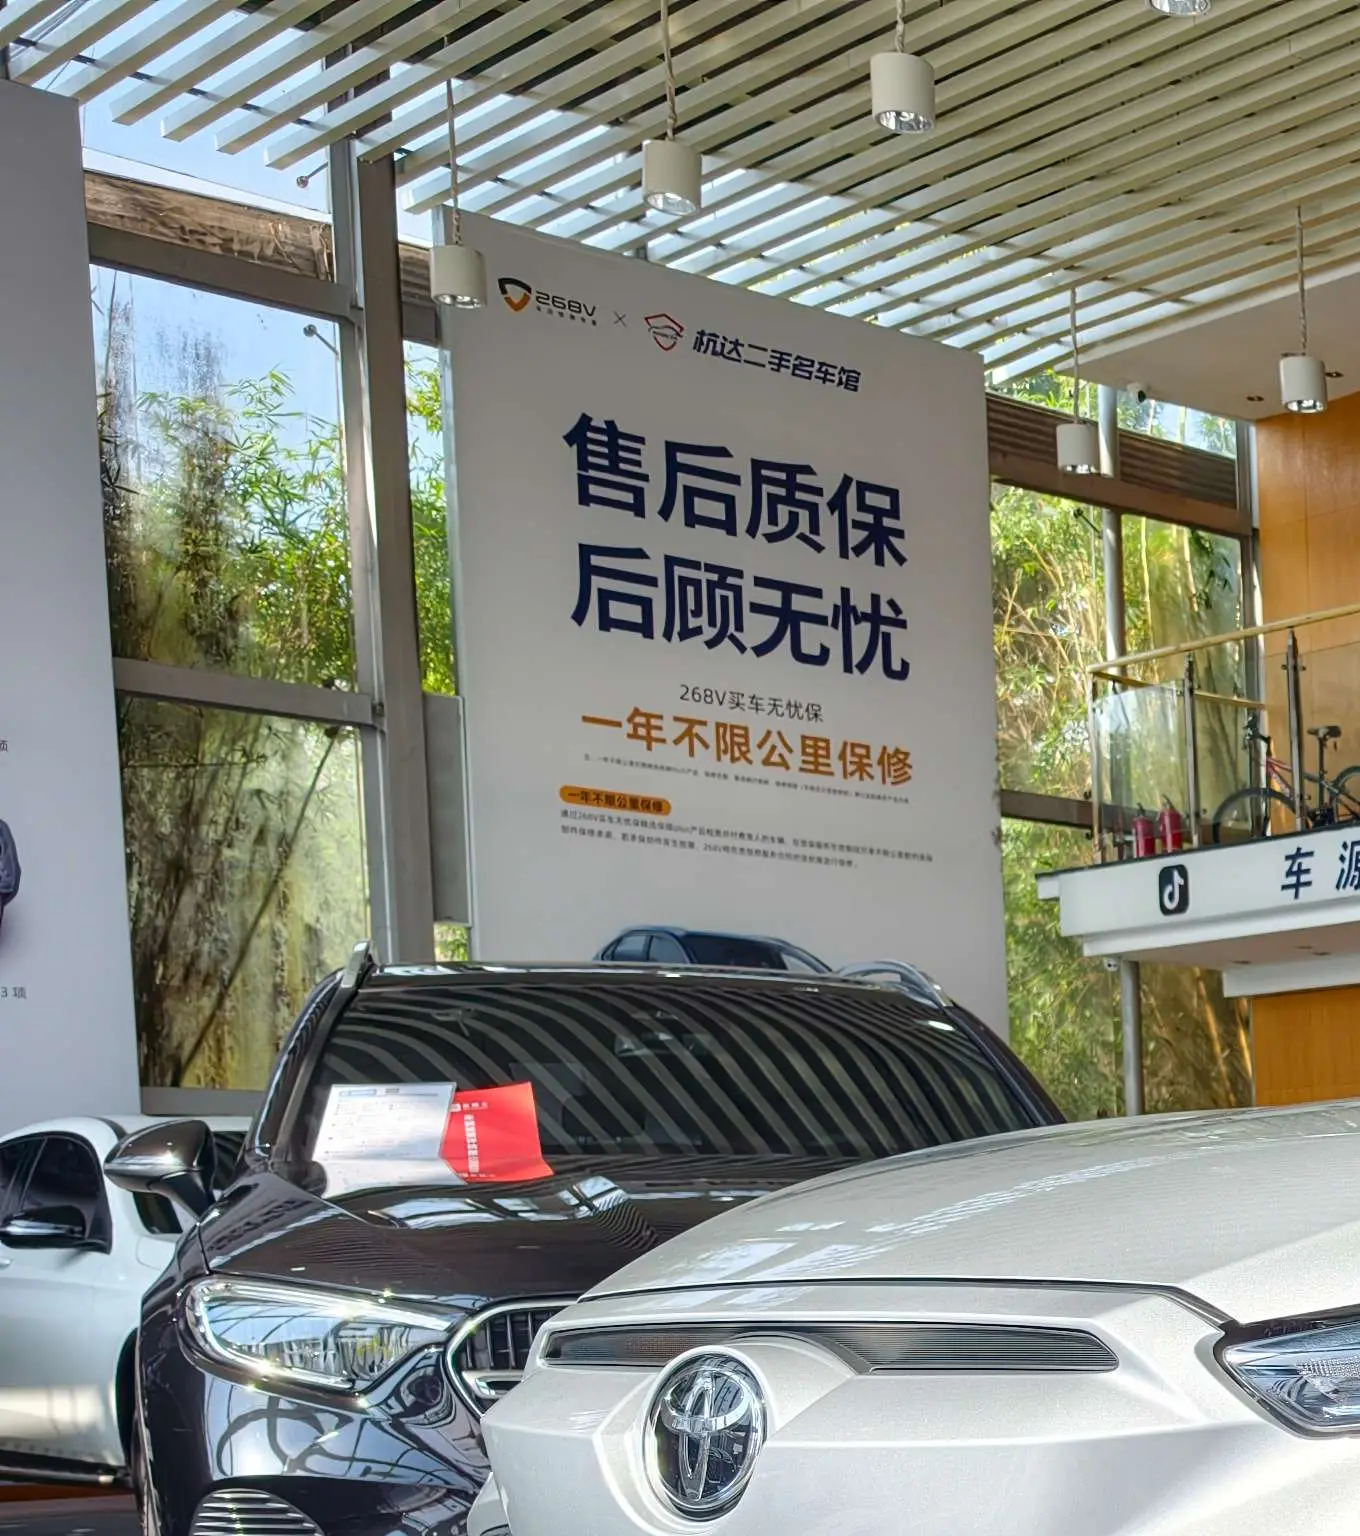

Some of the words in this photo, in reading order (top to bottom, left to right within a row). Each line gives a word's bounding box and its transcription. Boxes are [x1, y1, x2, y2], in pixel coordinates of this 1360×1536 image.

[535, 290, 597, 317] 268V
[692, 328, 862, 393] 杭达二手名车馆
[562, 411, 908, 569] 售后质保
[570, 541, 912, 681] 后顾无忧
[679, 683, 825, 724] 268V买车无忧保
[581, 706, 914, 786] 一年不限公里保修
